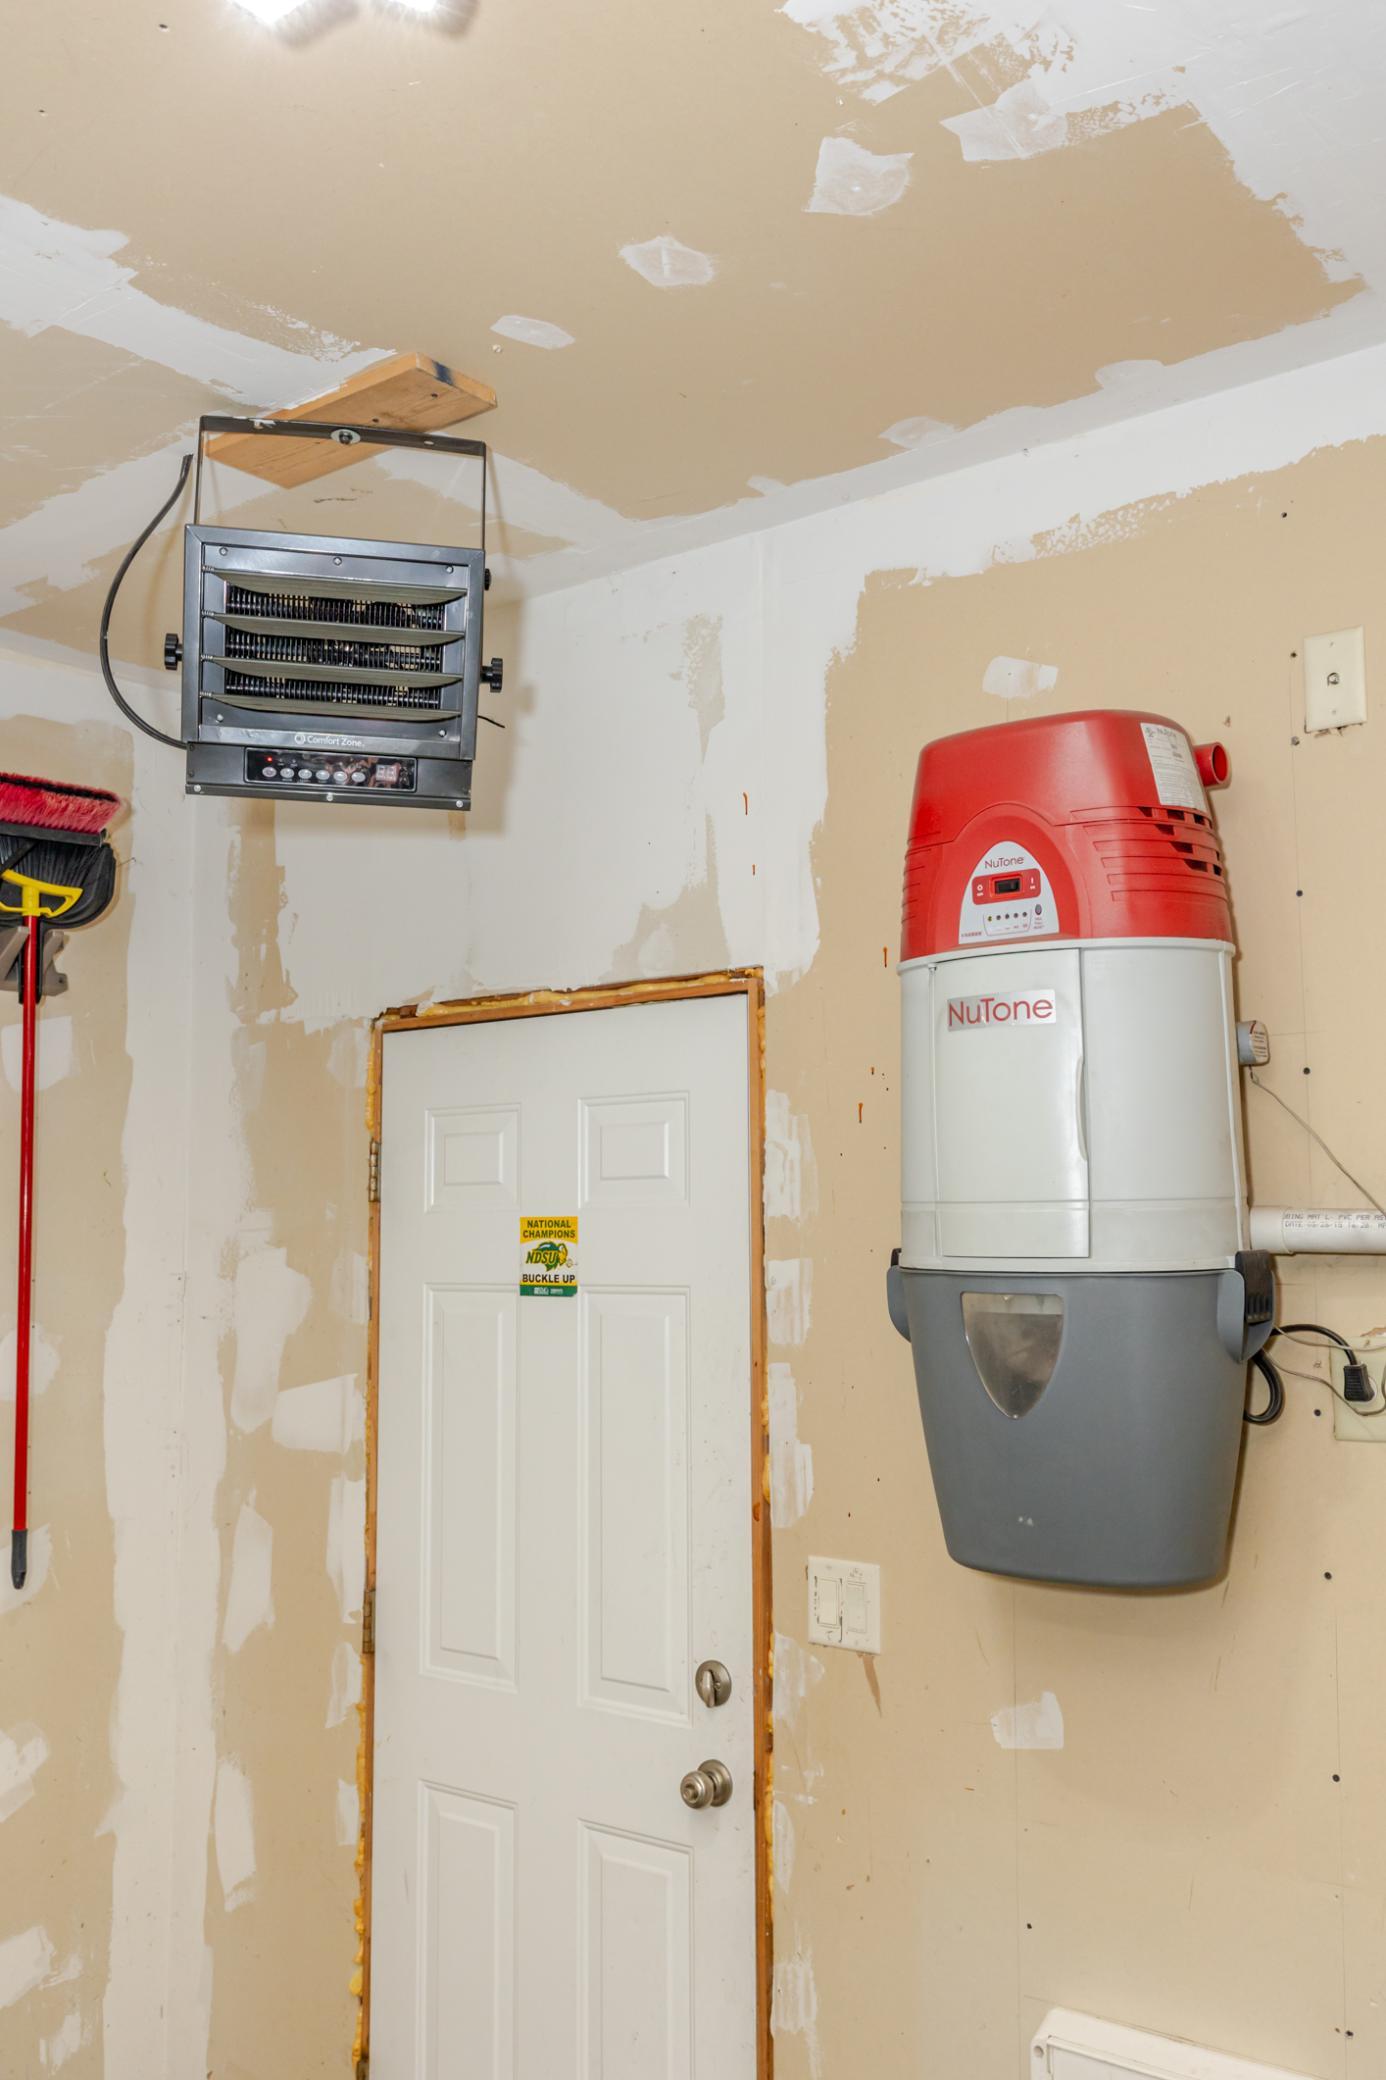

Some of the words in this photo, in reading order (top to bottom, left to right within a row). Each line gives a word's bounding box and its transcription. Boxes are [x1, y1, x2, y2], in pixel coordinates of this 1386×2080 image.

[307, 735, 340, 746] Comfort
[341, 737, 363, 747] Zone
[984, 856, 1025, 869] NuTone
[948, 998, 1053, 1027] NuTone
[527, 1219, 572, 1229] NATIONAL
[522, 1229, 576, 1239] CHAMPIONS
[525, 1250, 559, 1265] NDSU
[522, 1273, 560, 1283] BUCKLE
[562, 1274, 576, 1284] UP
